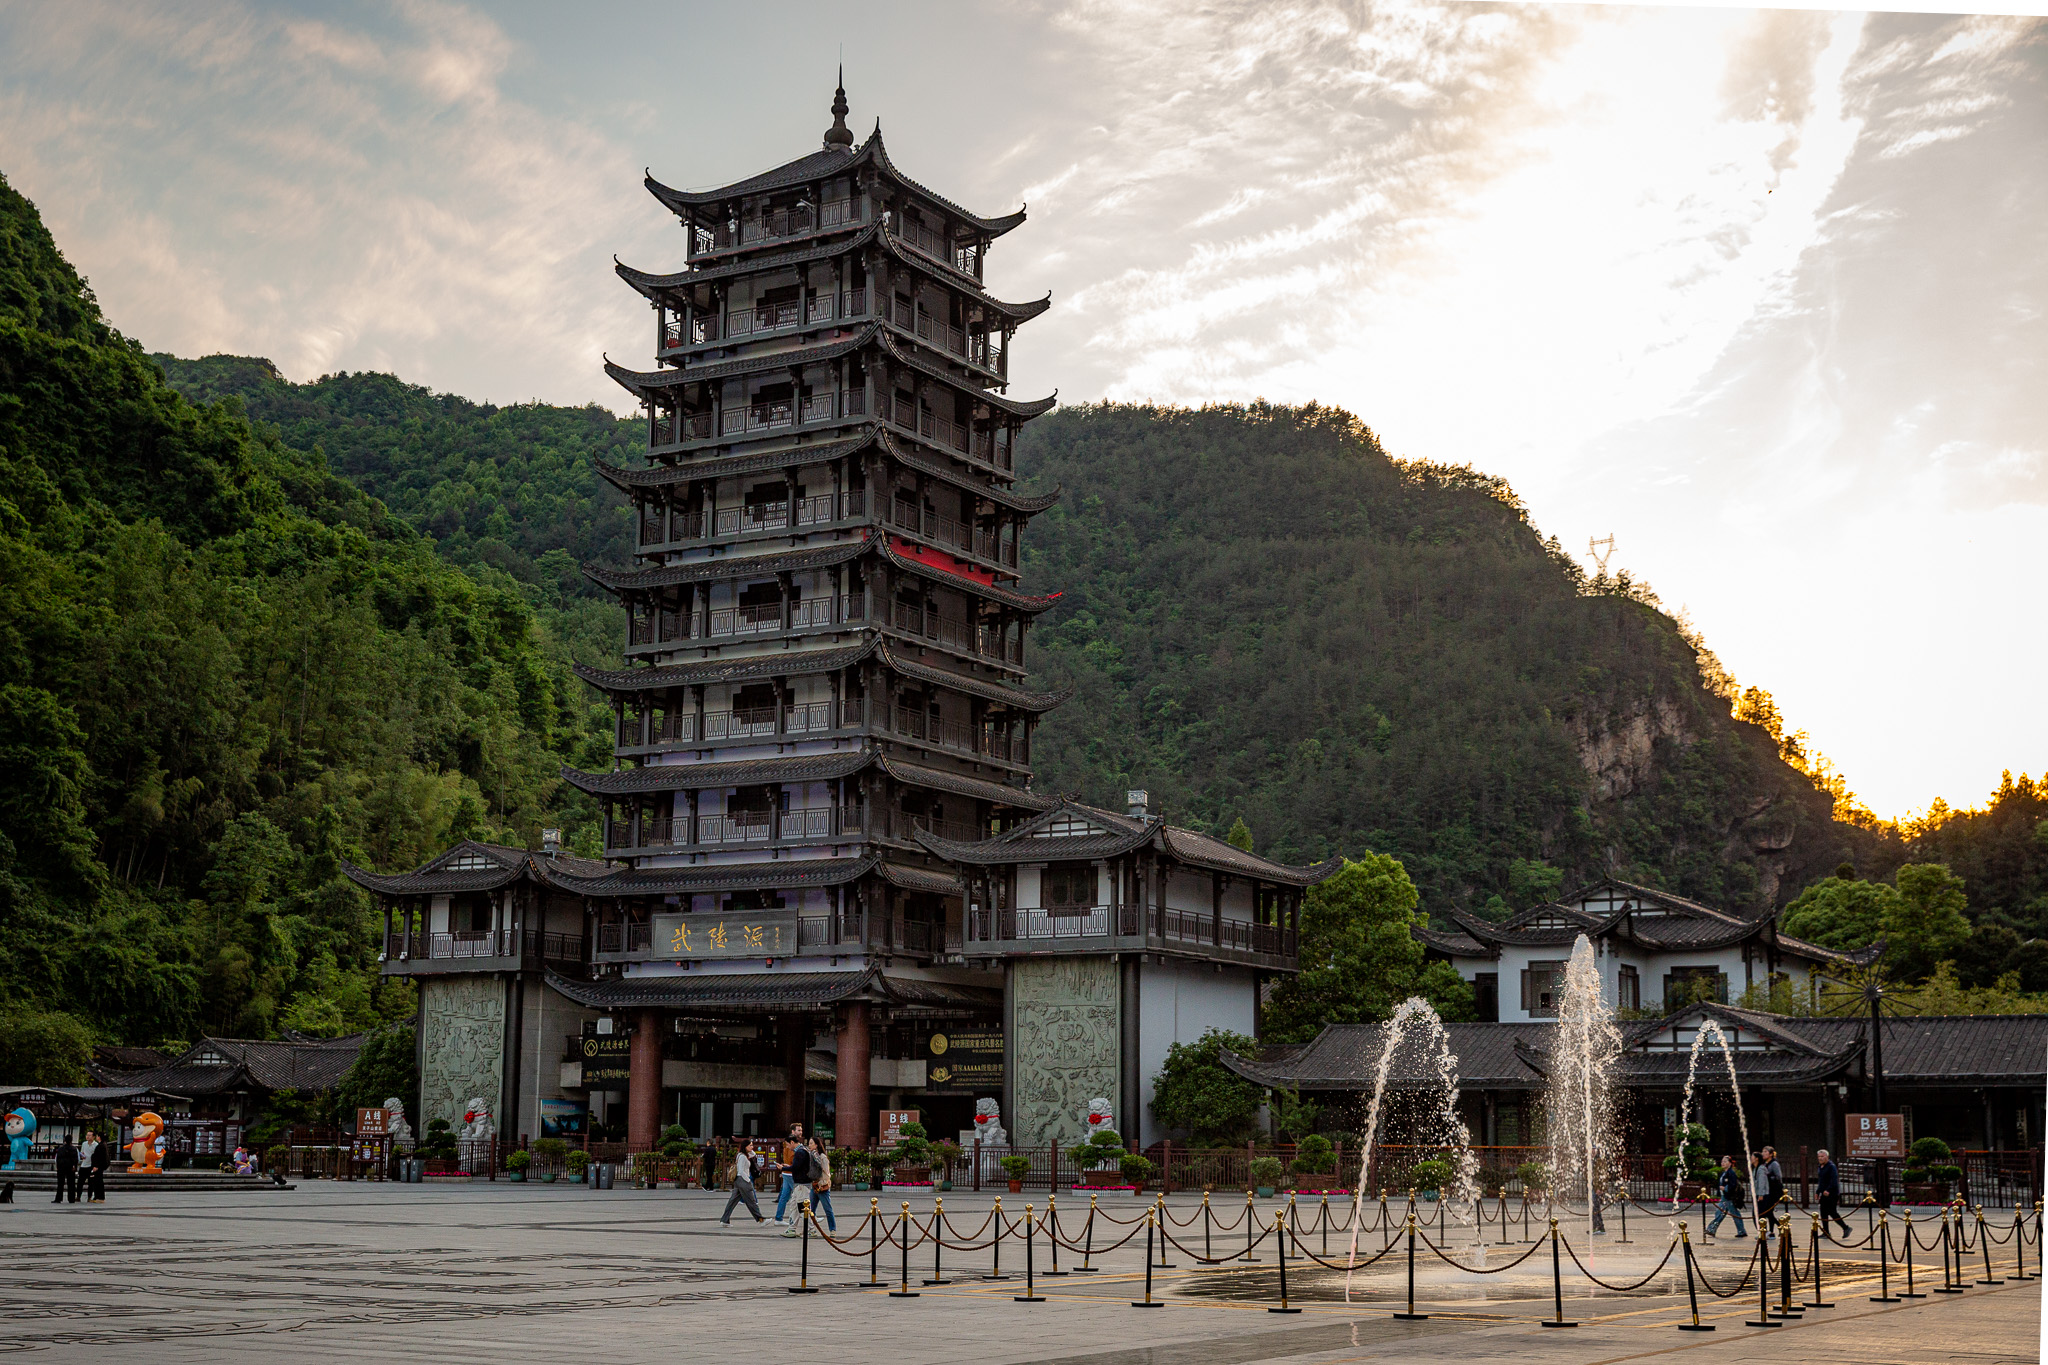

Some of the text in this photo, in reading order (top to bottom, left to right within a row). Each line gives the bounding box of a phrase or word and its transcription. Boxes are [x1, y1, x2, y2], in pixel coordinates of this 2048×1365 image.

[670, 921, 763, 952] 武陵源
[365, 1110, 371, 1120] A
[889, 1113, 909, 1124] B 线
[1860, 1118, 1888, 1130] B 线
